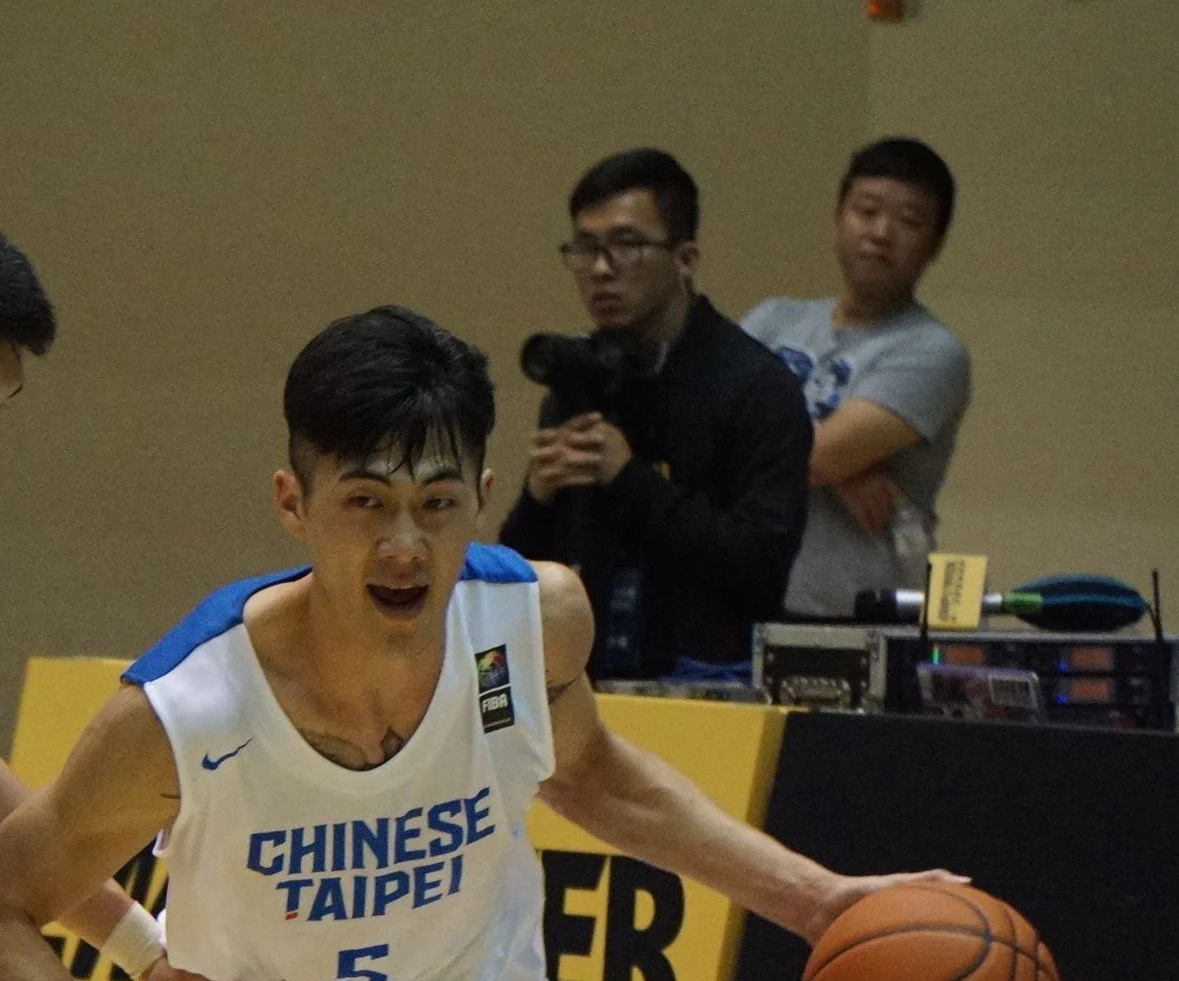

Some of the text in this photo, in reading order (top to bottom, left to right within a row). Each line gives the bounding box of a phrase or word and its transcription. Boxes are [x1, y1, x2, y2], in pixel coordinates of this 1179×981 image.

[481, 693, 509, 713] FIBA
[246, 787, 496, 876] CHINESE
[276, 854, 463, 921] TAIPEI
